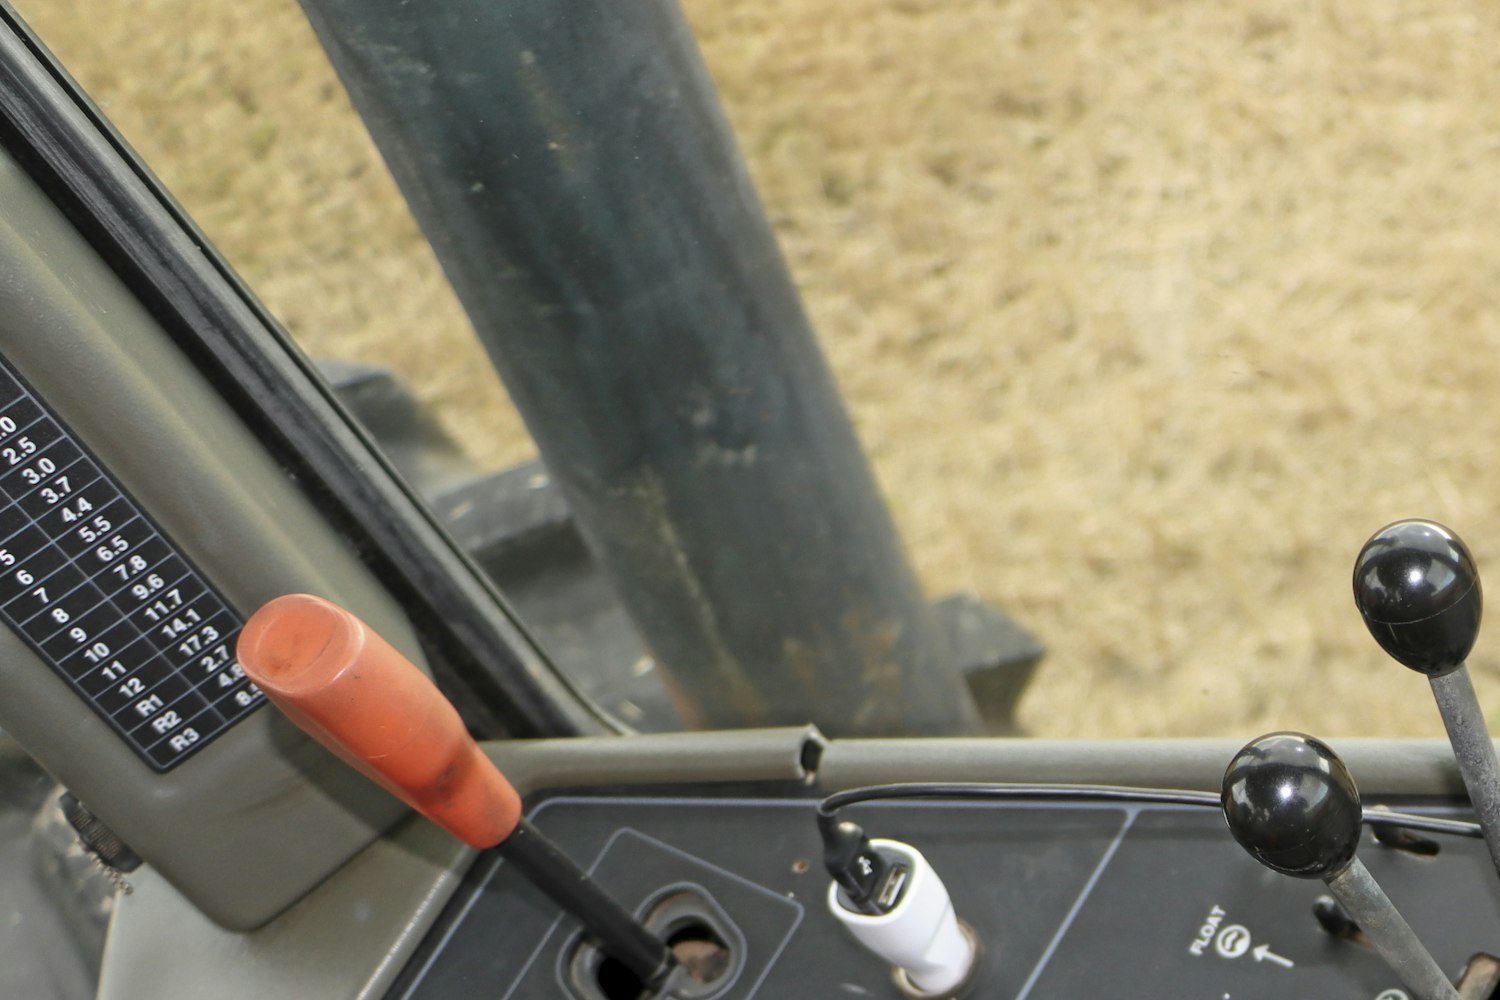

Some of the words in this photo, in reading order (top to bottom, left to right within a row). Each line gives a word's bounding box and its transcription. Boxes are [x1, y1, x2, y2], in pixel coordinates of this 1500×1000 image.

[0, 416, 17, 440] .0
[2, 436, 36, 465] 2.5
[22, 457, 56, 484] 3.0
[41, 476, 71, 504] 3.7
[0, 549, 15, 565] 5
[62, 496, 93, 522] 4.4
[16, 569, 34, 585] 6
[78, 516, 111, 542] 5.5
[32, 587, 49, 603] 7
[97, 535, 129, 561] 6.5
[51, 608, 70, 623] 8
[113, 555, 148, 580] 7.8
[70, 627, 87, 643] 9
[132, 573, 164, 599] 9.6
[84, 642, 110, 662] 10
[145, 588, 182, 620] 11.7
[102, 660, 127, 680] 11
[162, 608, 201, 638] 14.1
[119, 677, 146, 698] 12
[179, 626, 219, 656] 17.3
[135, 694, 164, 717] R1
[201, 644, 229, 672] 2.7
[152, 710, 182, 734] R2
[169, 727, 199, 752] R3
[1188, 904, 1226, 956] FLOAT
